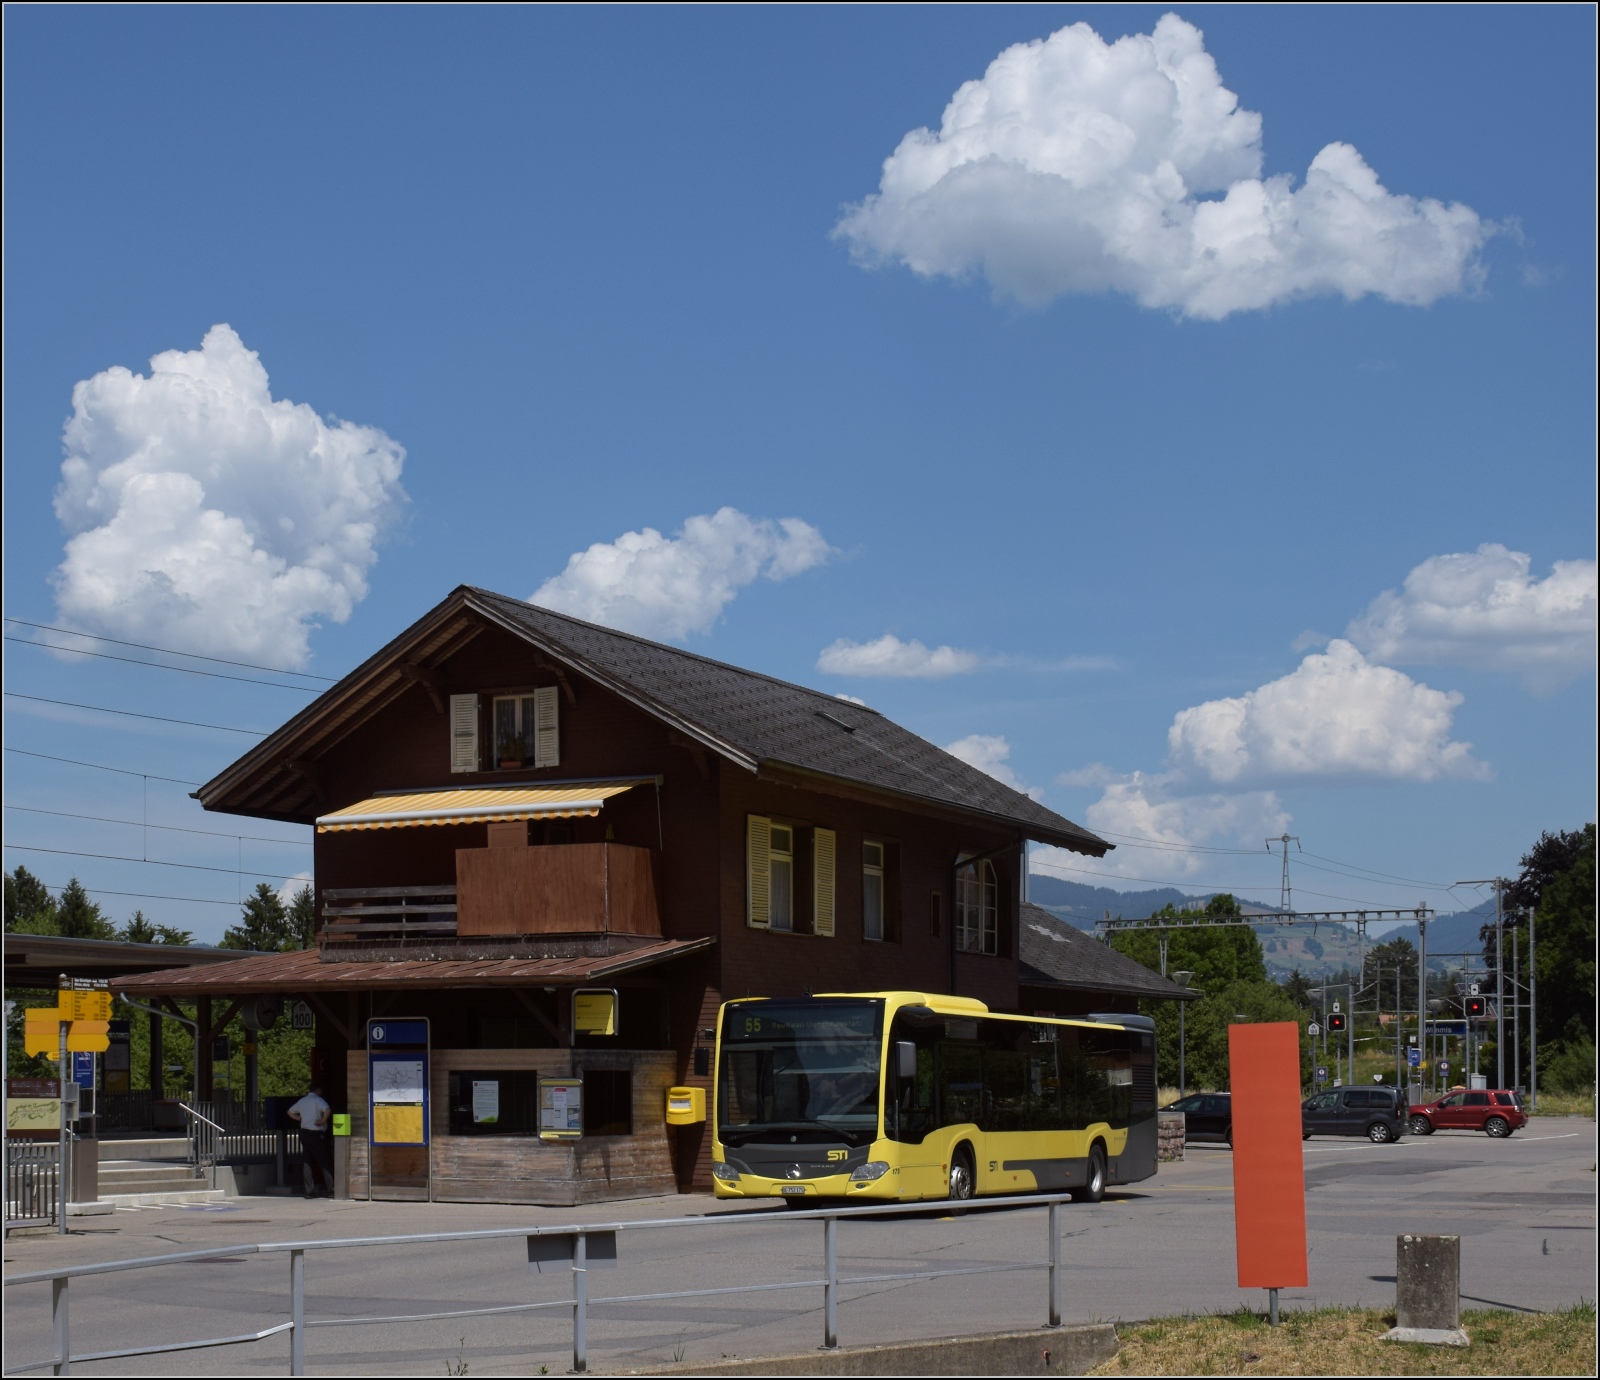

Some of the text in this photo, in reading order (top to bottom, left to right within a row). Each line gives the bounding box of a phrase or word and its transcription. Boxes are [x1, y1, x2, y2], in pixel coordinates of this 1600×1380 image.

[294, 1013, 310, 1026] 100
[745, 1017, 762, 1032] 55
[1425, 1026, 1452, 1034] Wimmis
[827, 1149, 848, 1161] STI
